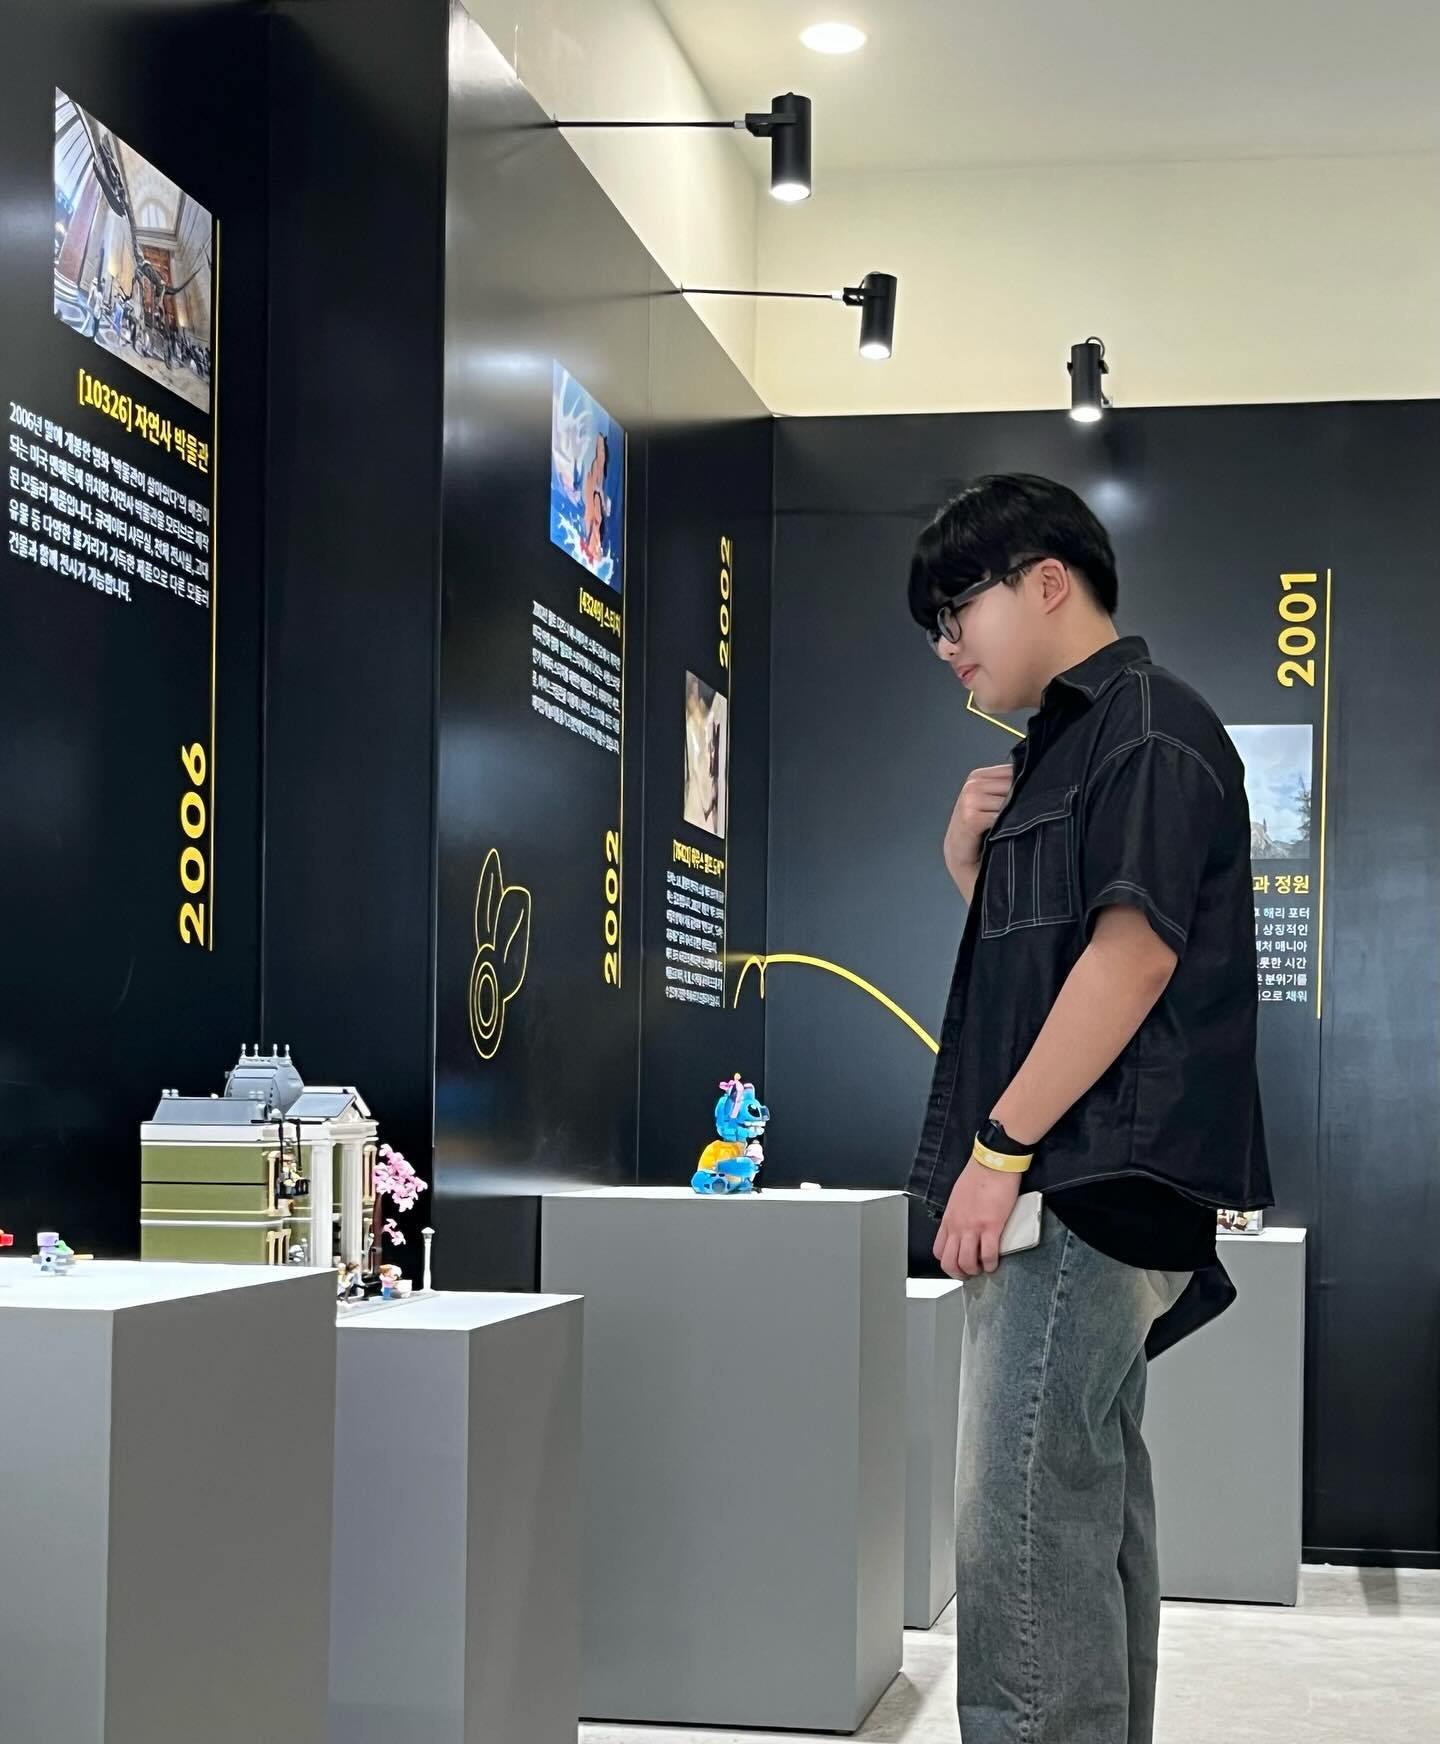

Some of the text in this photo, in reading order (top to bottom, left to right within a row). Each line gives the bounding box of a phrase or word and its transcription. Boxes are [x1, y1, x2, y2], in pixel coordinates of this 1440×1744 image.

[10, 402, 42, 437] 2006년
[65, 432, 91, 462] 개봉한
[92, 447, 109, 472] 영화
[79, 368, 208, 473] [10326] 자연사 박물관
[9, 466, 19, 490] 된
[21, 472, 48, 503] 모듈러
[49, 486, 94, 524] 제품입니다.
[95, 508, 127, 542] 큐레이터
[129, 526, 154, 557] 사무실,
[10, 434, 29, 462] 되는
[30, 445, 48, 472] 미국
[85, 473, 109, 503] 위치한
[110, 486, 134, 515] 자연사
[135, 499, 164, 531] 박물관을
[195, 530, 209, 554] 제작
[9, 499, 209, 608] 유물 등 다양한 볼거리가 가득한 제품으로 다른 모듈러
[9, 530, 132, 602] 건물과 함께 전시가 가능합니다.
[719, 536, 730, 669] 2002
[1277, 573, 1317, 687] 2001
[179, 742, 206, 947] 2006
[604, 830, 619, 985] 2002
[1253, 875, 1309, 894] 과 정원
[1263, 907, 1285, 919] 해리
[1288, 907, 1310, 919] 포터
[1263, 924, 1308, 936] 상징적인
[1275, 941, 1308, 953] 매니아
[1285, 957, 1307, 969] 시간
[1258, 990, 1308, 1002] 으로 채워
[1265, 974, 1307, 986] 분위기를
